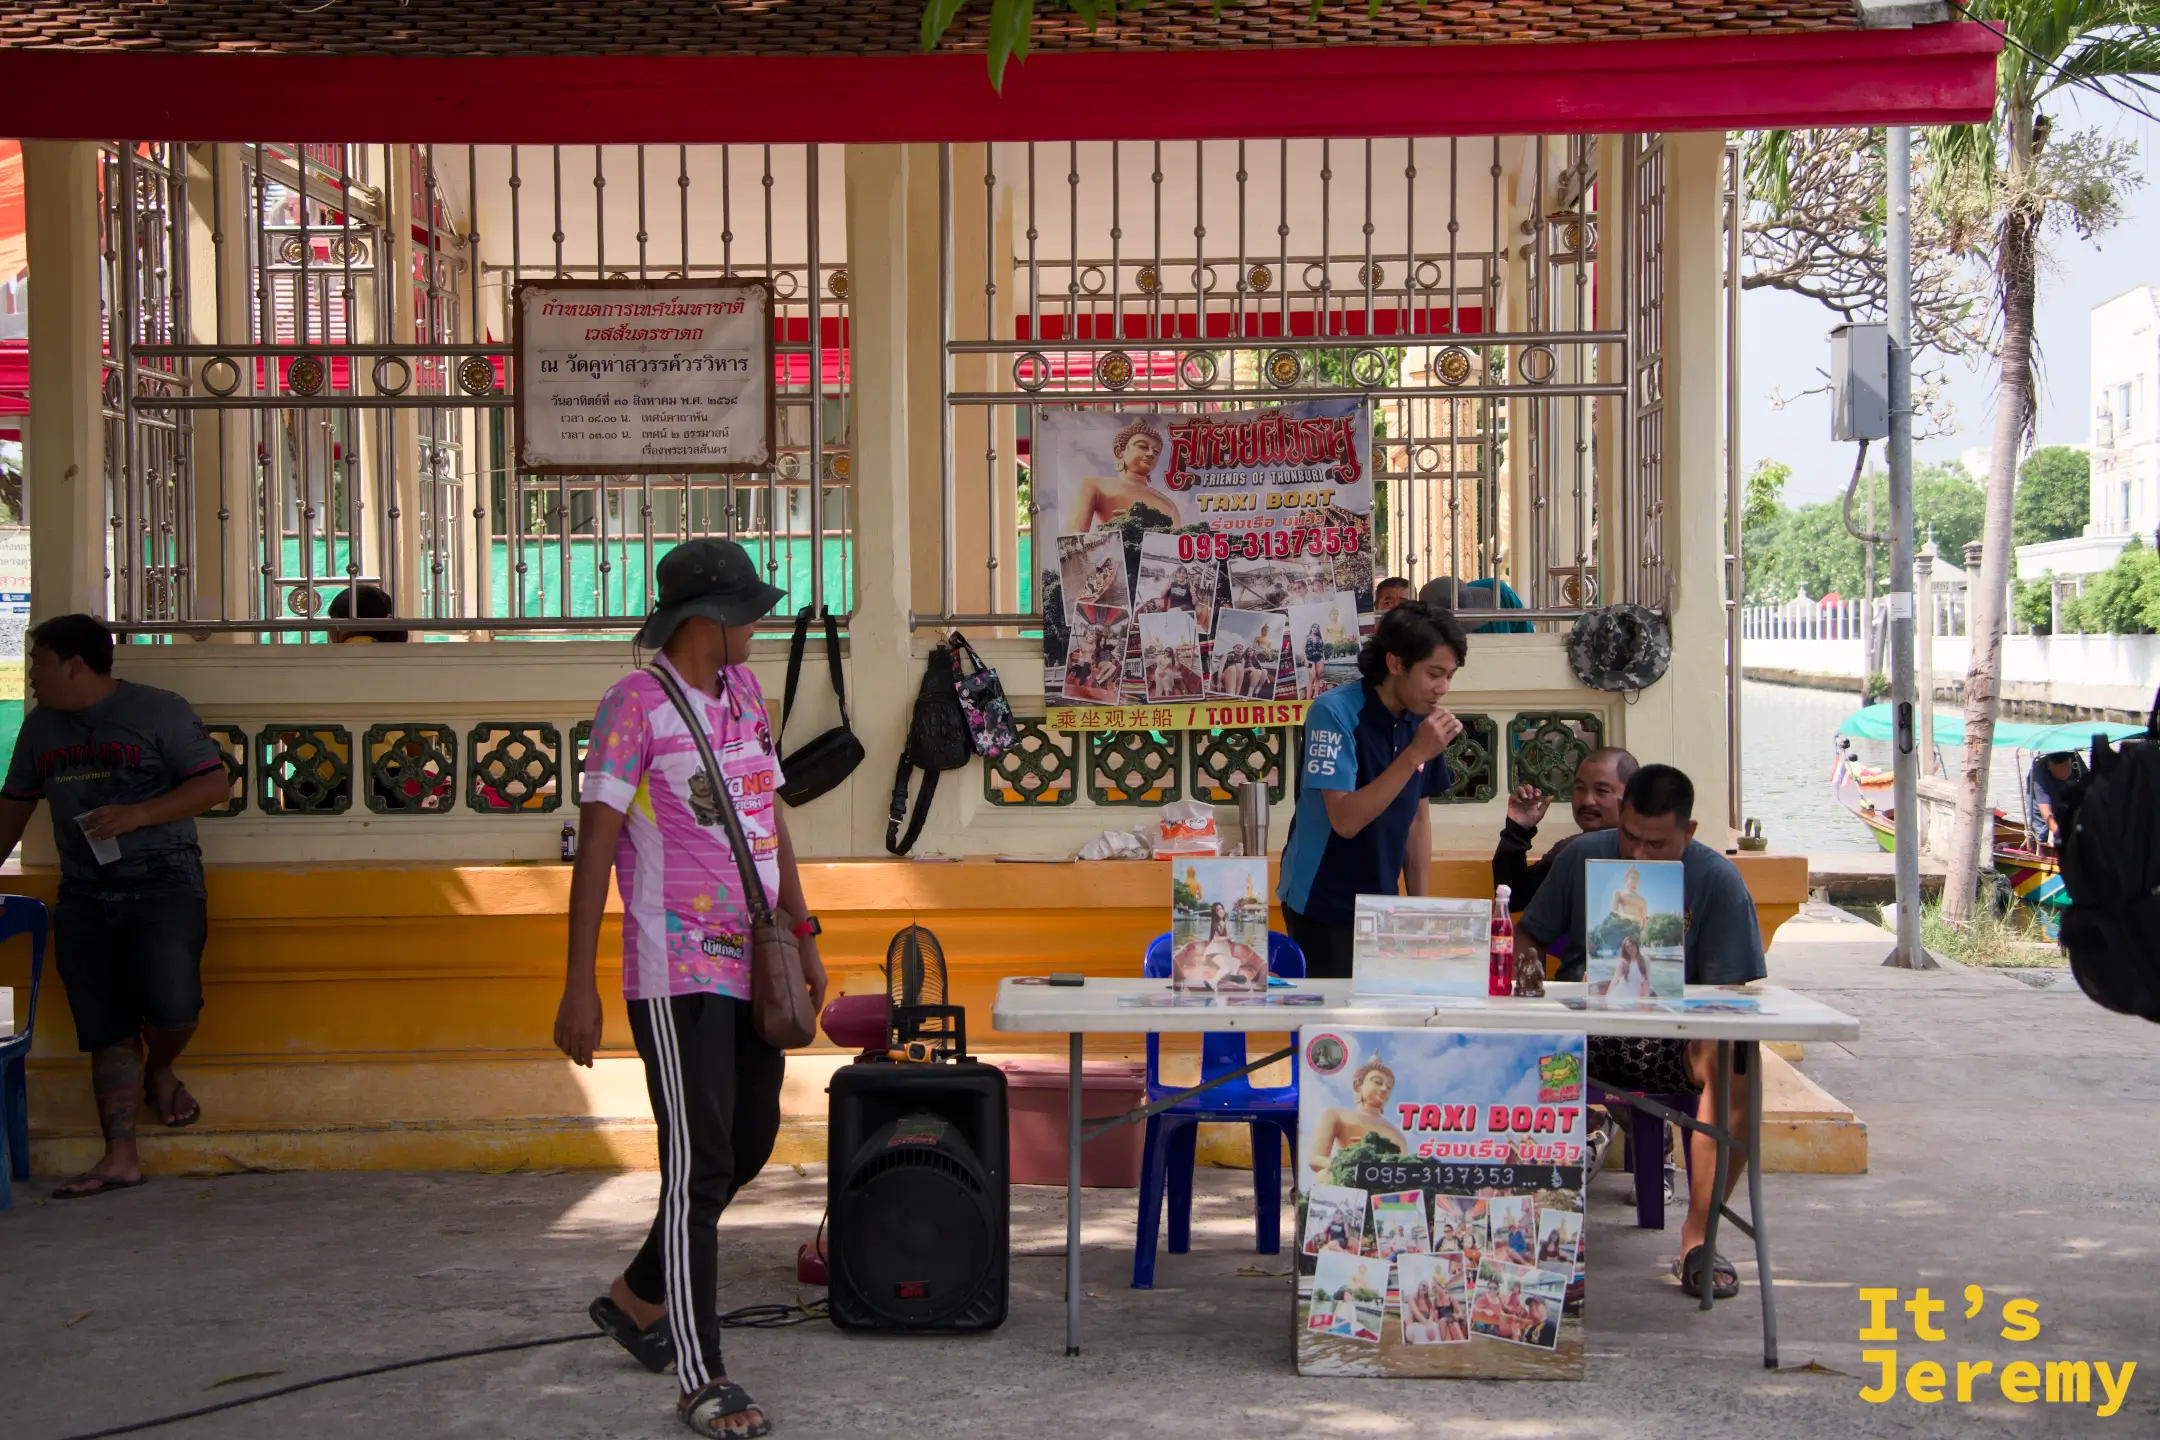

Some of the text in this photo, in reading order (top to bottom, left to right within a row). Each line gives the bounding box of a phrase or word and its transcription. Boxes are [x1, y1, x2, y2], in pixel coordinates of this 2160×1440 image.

[541, 296, 746, 317] กำหนดการเทศน์มหาชาติ
[584, 322, 704, 341] เวสสันดรชาดก
[541, 353, 748, 379] ณ วัดคูหาสวรรค์วรวิหาร
[551, 391, 738, 406] วันอาทิตย์ที่ ๓๑ สิงหาคม พ.ศ. ๒๕๖๘
[560, 411, 708, 423] เวลา ๐๘.๐๐ น. เทศน์คาถาพัน
[561, 426, 729, 440] เวลา ๑๓.๐๐ น. เทศน์ ๒ ธรรมาสน์
[642, 441, 728, 455] เรื่องพระเวสสันดร
[1201, 468, 1325, 487] FRIENDS OF THONBURI
[1197, 488, 1336, 513] TAXI BOAT
[1178, 526, 1359, 563] 095-3137353
[1056, 707, 1173, 729] 乘坐观光船
[1206, 704, 1304, 726] TOURIST
[1310, 729, 1343, 745] NEW
[1307, 759, 1336, 776] 65
[1398, 1103, 1580, 1134] TAXI BOAT
[1365, 1165, 1515, 1184] 095-3137353
